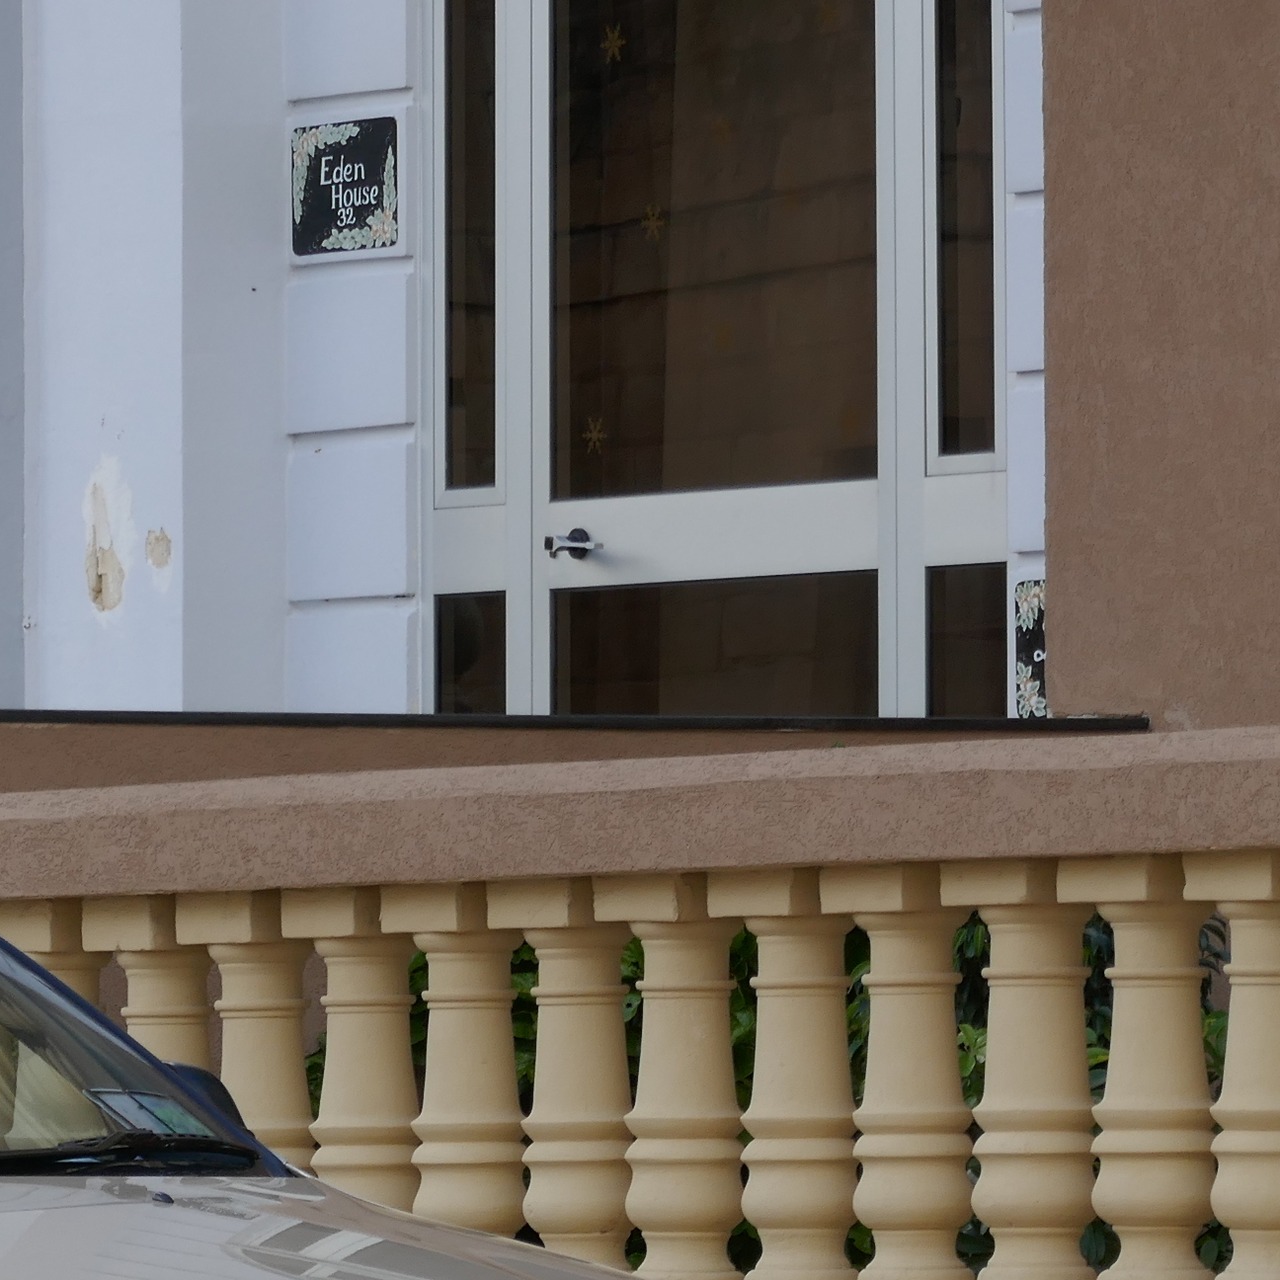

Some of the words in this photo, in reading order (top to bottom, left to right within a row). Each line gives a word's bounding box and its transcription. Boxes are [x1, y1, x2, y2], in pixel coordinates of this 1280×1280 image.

[319, 154, 366, 186] Eden
[330, 184, 380, 210] House
[336, 206, 357, 227] 32
